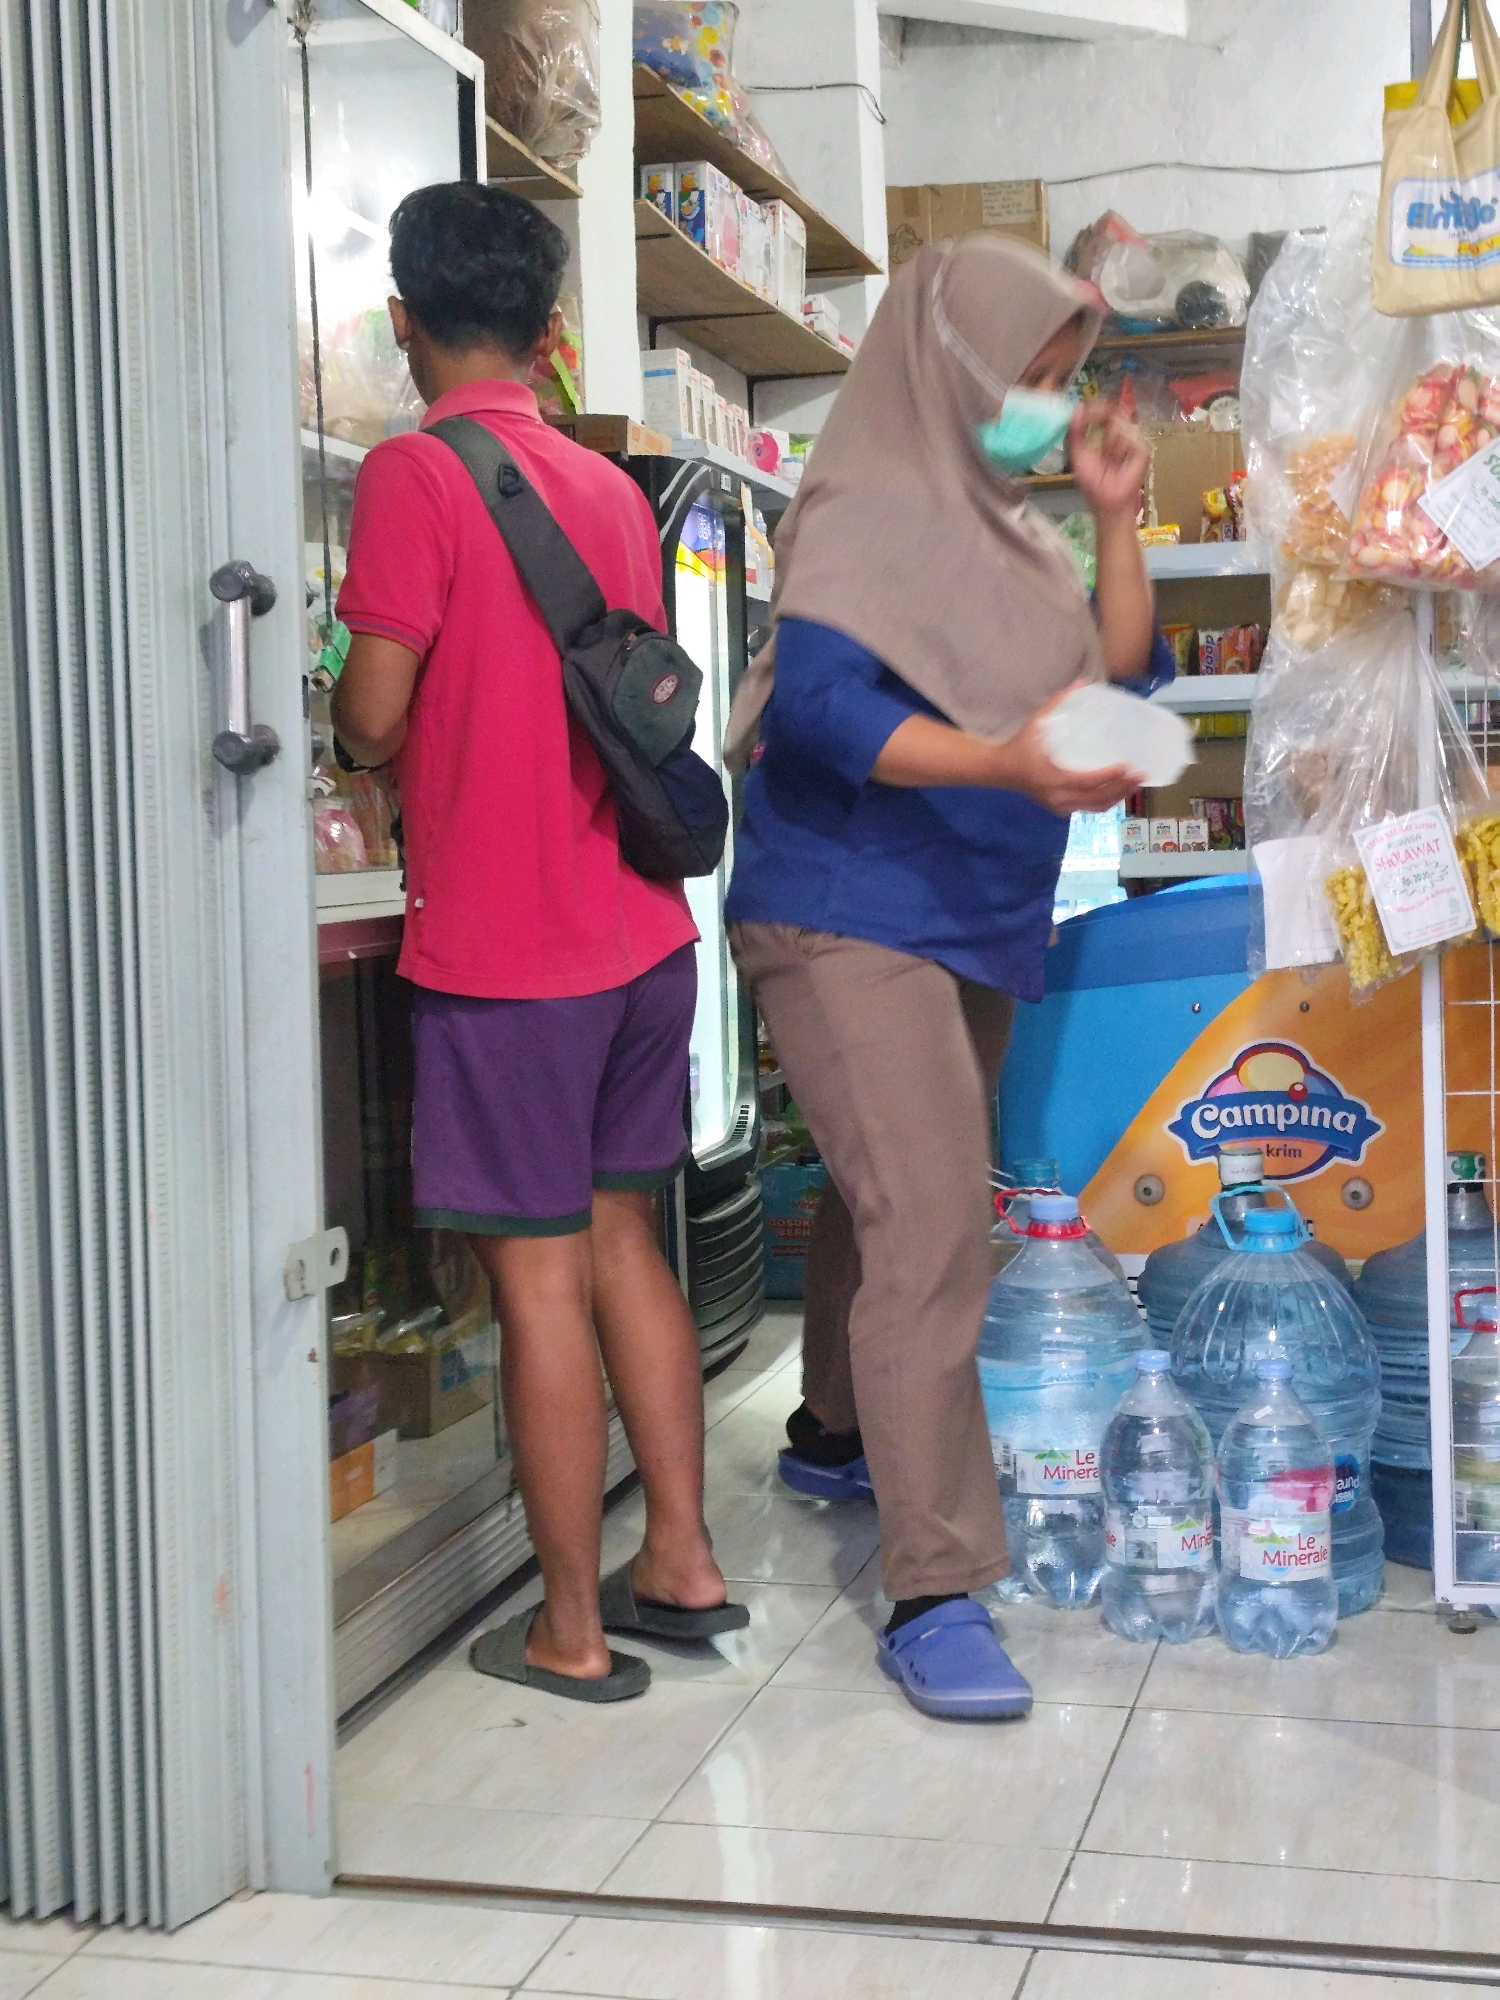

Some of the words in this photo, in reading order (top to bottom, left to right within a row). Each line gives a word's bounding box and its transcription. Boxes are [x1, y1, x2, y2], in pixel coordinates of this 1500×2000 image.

[1374, 838, 1440, 872] SHOLAWAT
[1190, 1103, 1358, 1140] Campina
[1266, 1143, 1303, 1158] krim
[1075, 1449, 1096, 1465] Le
[1043, 1464, 1101, 1481] Minera
[1297, 1533, 1316, 1551] Le
[1261, 1546, 1329, 1567] Minerale
